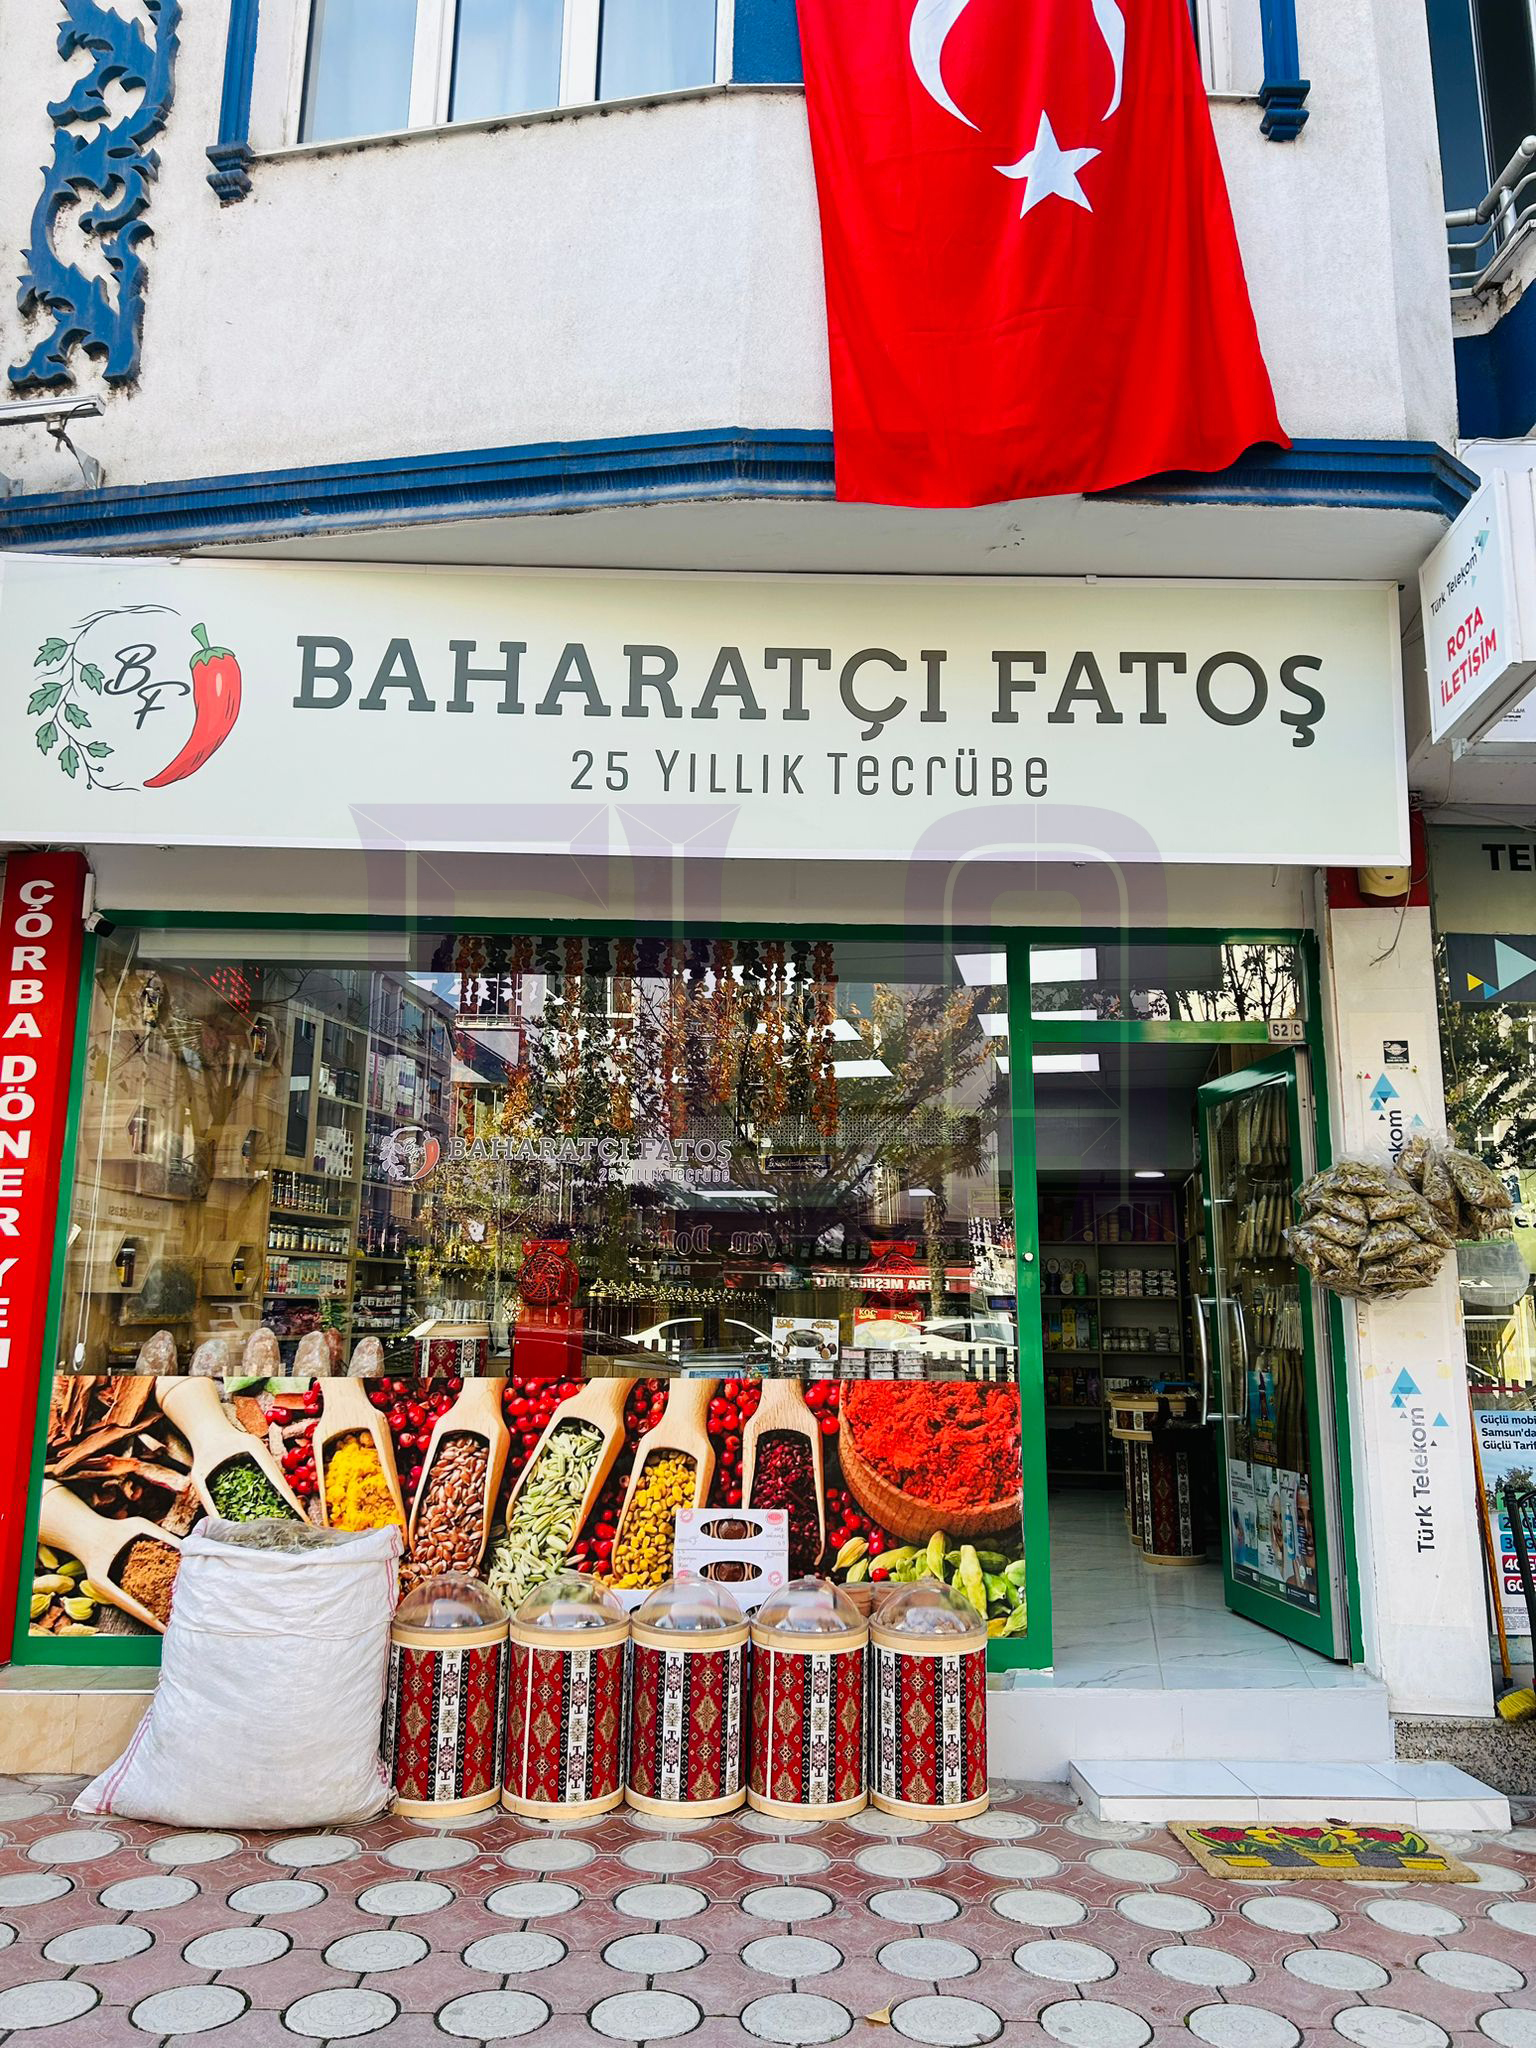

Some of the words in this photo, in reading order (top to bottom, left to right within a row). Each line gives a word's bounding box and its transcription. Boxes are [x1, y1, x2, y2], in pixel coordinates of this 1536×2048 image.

[1430, 591, 1446, 617] Türk
[1446, 553, 1478, 597] Telekom
[1446, 605, 1484, 662] ROTA
[293, 635, 948, 741] BAHARATÇI
[992, 650, 1327, 748] FATOŞ
[1440, 628, 1498, 707] İLETİŞİM
[570, 749, 629, 792] 25
[655, 750, 805, 795] YILLIK
[1482, 843, 1536, 871] TE
[2, 880, 55, 1038] ÇORBA
[449, 1137, 629, 1165] BAHARATÇI
[640, 1137, 732, 1167] FATOŞ
[599, 1167, 618, 1183] 25
[1481, 1415, 1509, 1427] Güçlü
[1411, 1406, 1430, 1499] Telekom
[1484, 1441, 1512, 1452] Güçlü
[1415, 1505, 1436, 1553] Türk
